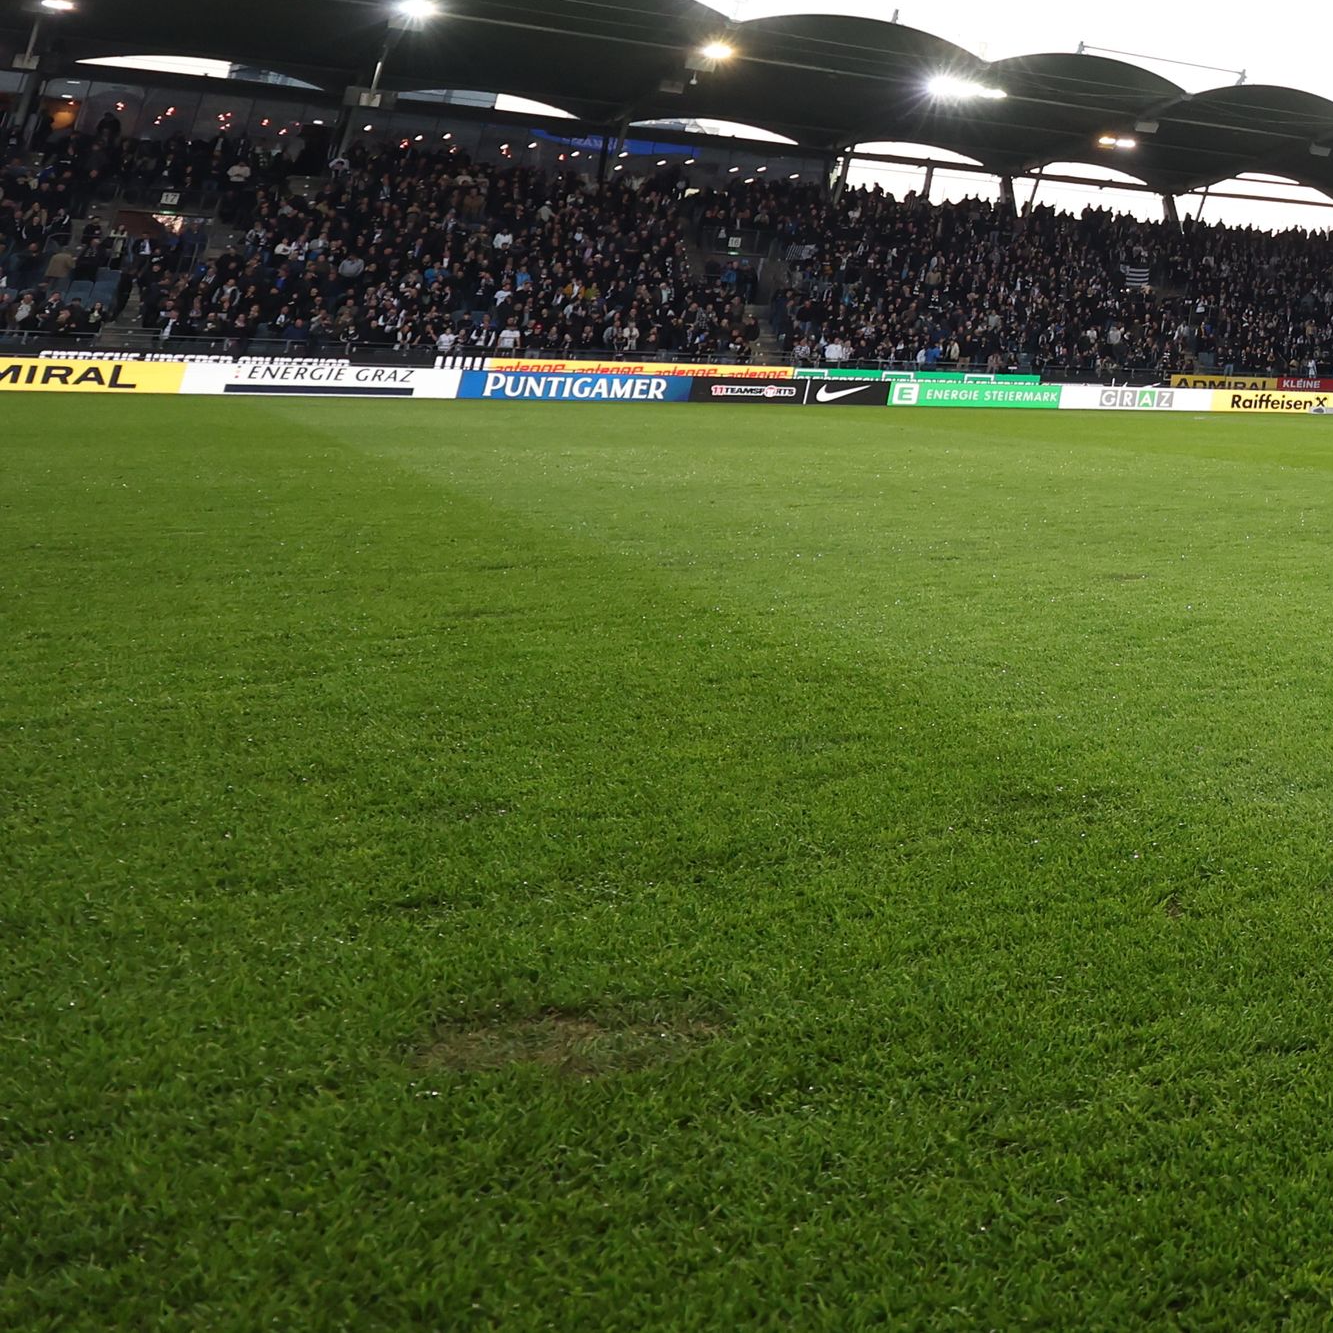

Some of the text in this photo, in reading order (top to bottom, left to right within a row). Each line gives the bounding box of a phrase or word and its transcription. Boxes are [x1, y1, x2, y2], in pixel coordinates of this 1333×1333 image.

[247, 365, 415, 383] ENERGIE GRAZ
[482, 371, 667, 400] PUNTIGAMER
[1282, 379, 1321, 389] KLEINE
[925, 388, 979, 401] ENERGIE
[983, 390, 1058, 403] STEIERMARK
[1101, 389, 1173, 407] GRAZ
[1231, 393, 1313, 412] Raiffeisen
